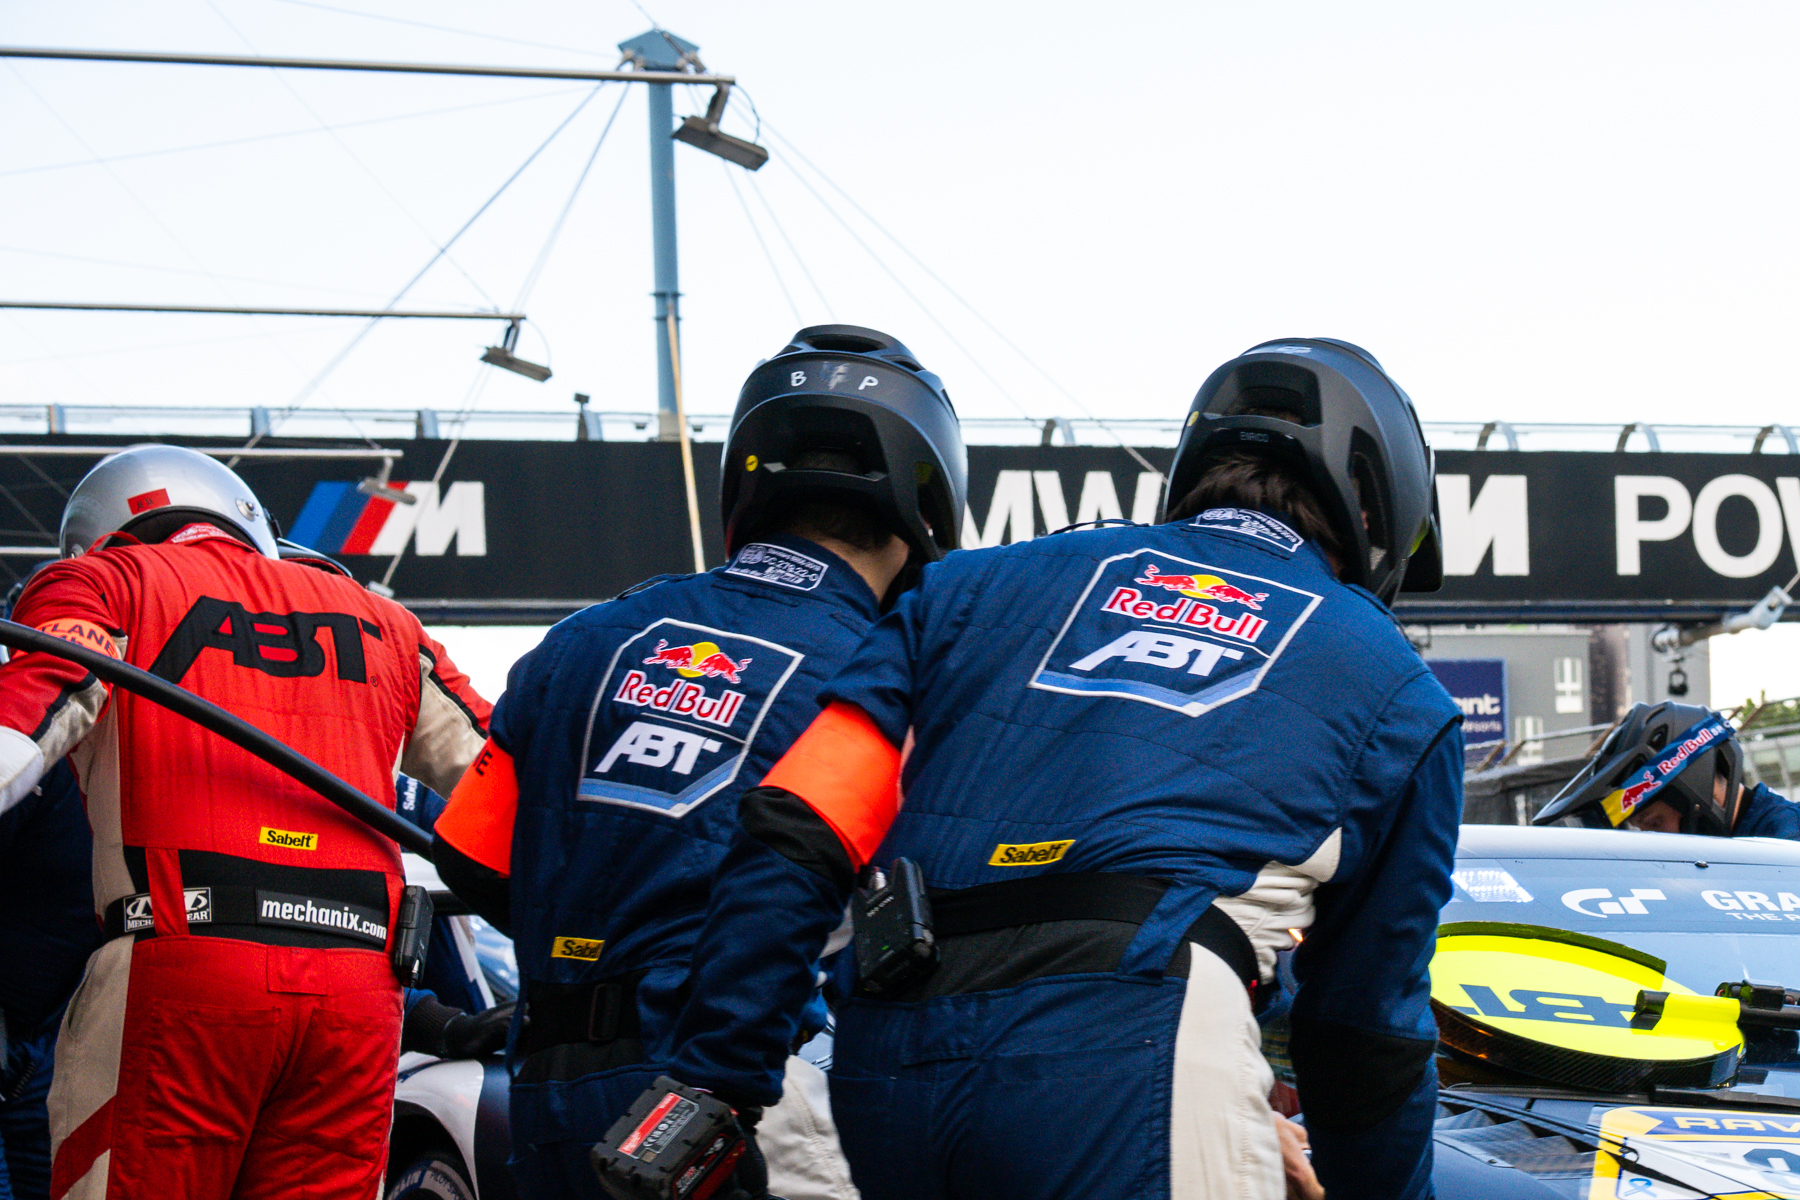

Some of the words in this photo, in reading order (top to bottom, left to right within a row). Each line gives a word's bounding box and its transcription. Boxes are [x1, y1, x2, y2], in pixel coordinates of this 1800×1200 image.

[963, 470, 1164, 549] MW
[148, 595, 383, 684] ABT
[1100, 586, 1192, 623] Red
[1178, 600, 1269, 643] Bull
[1068, 630, 1245, 677] ABT
[613, 669, 686, 711] Red
[669, 682, 746, 727] Bull
[593, 720, 723, 775] ABT
[266, 830, 314, 848] Sabelt
[1000, 843, 1066, 864] Sabelt
[262, 899, 387, 940] mechanix.com
[1726, 912, 1782, 921] THE
